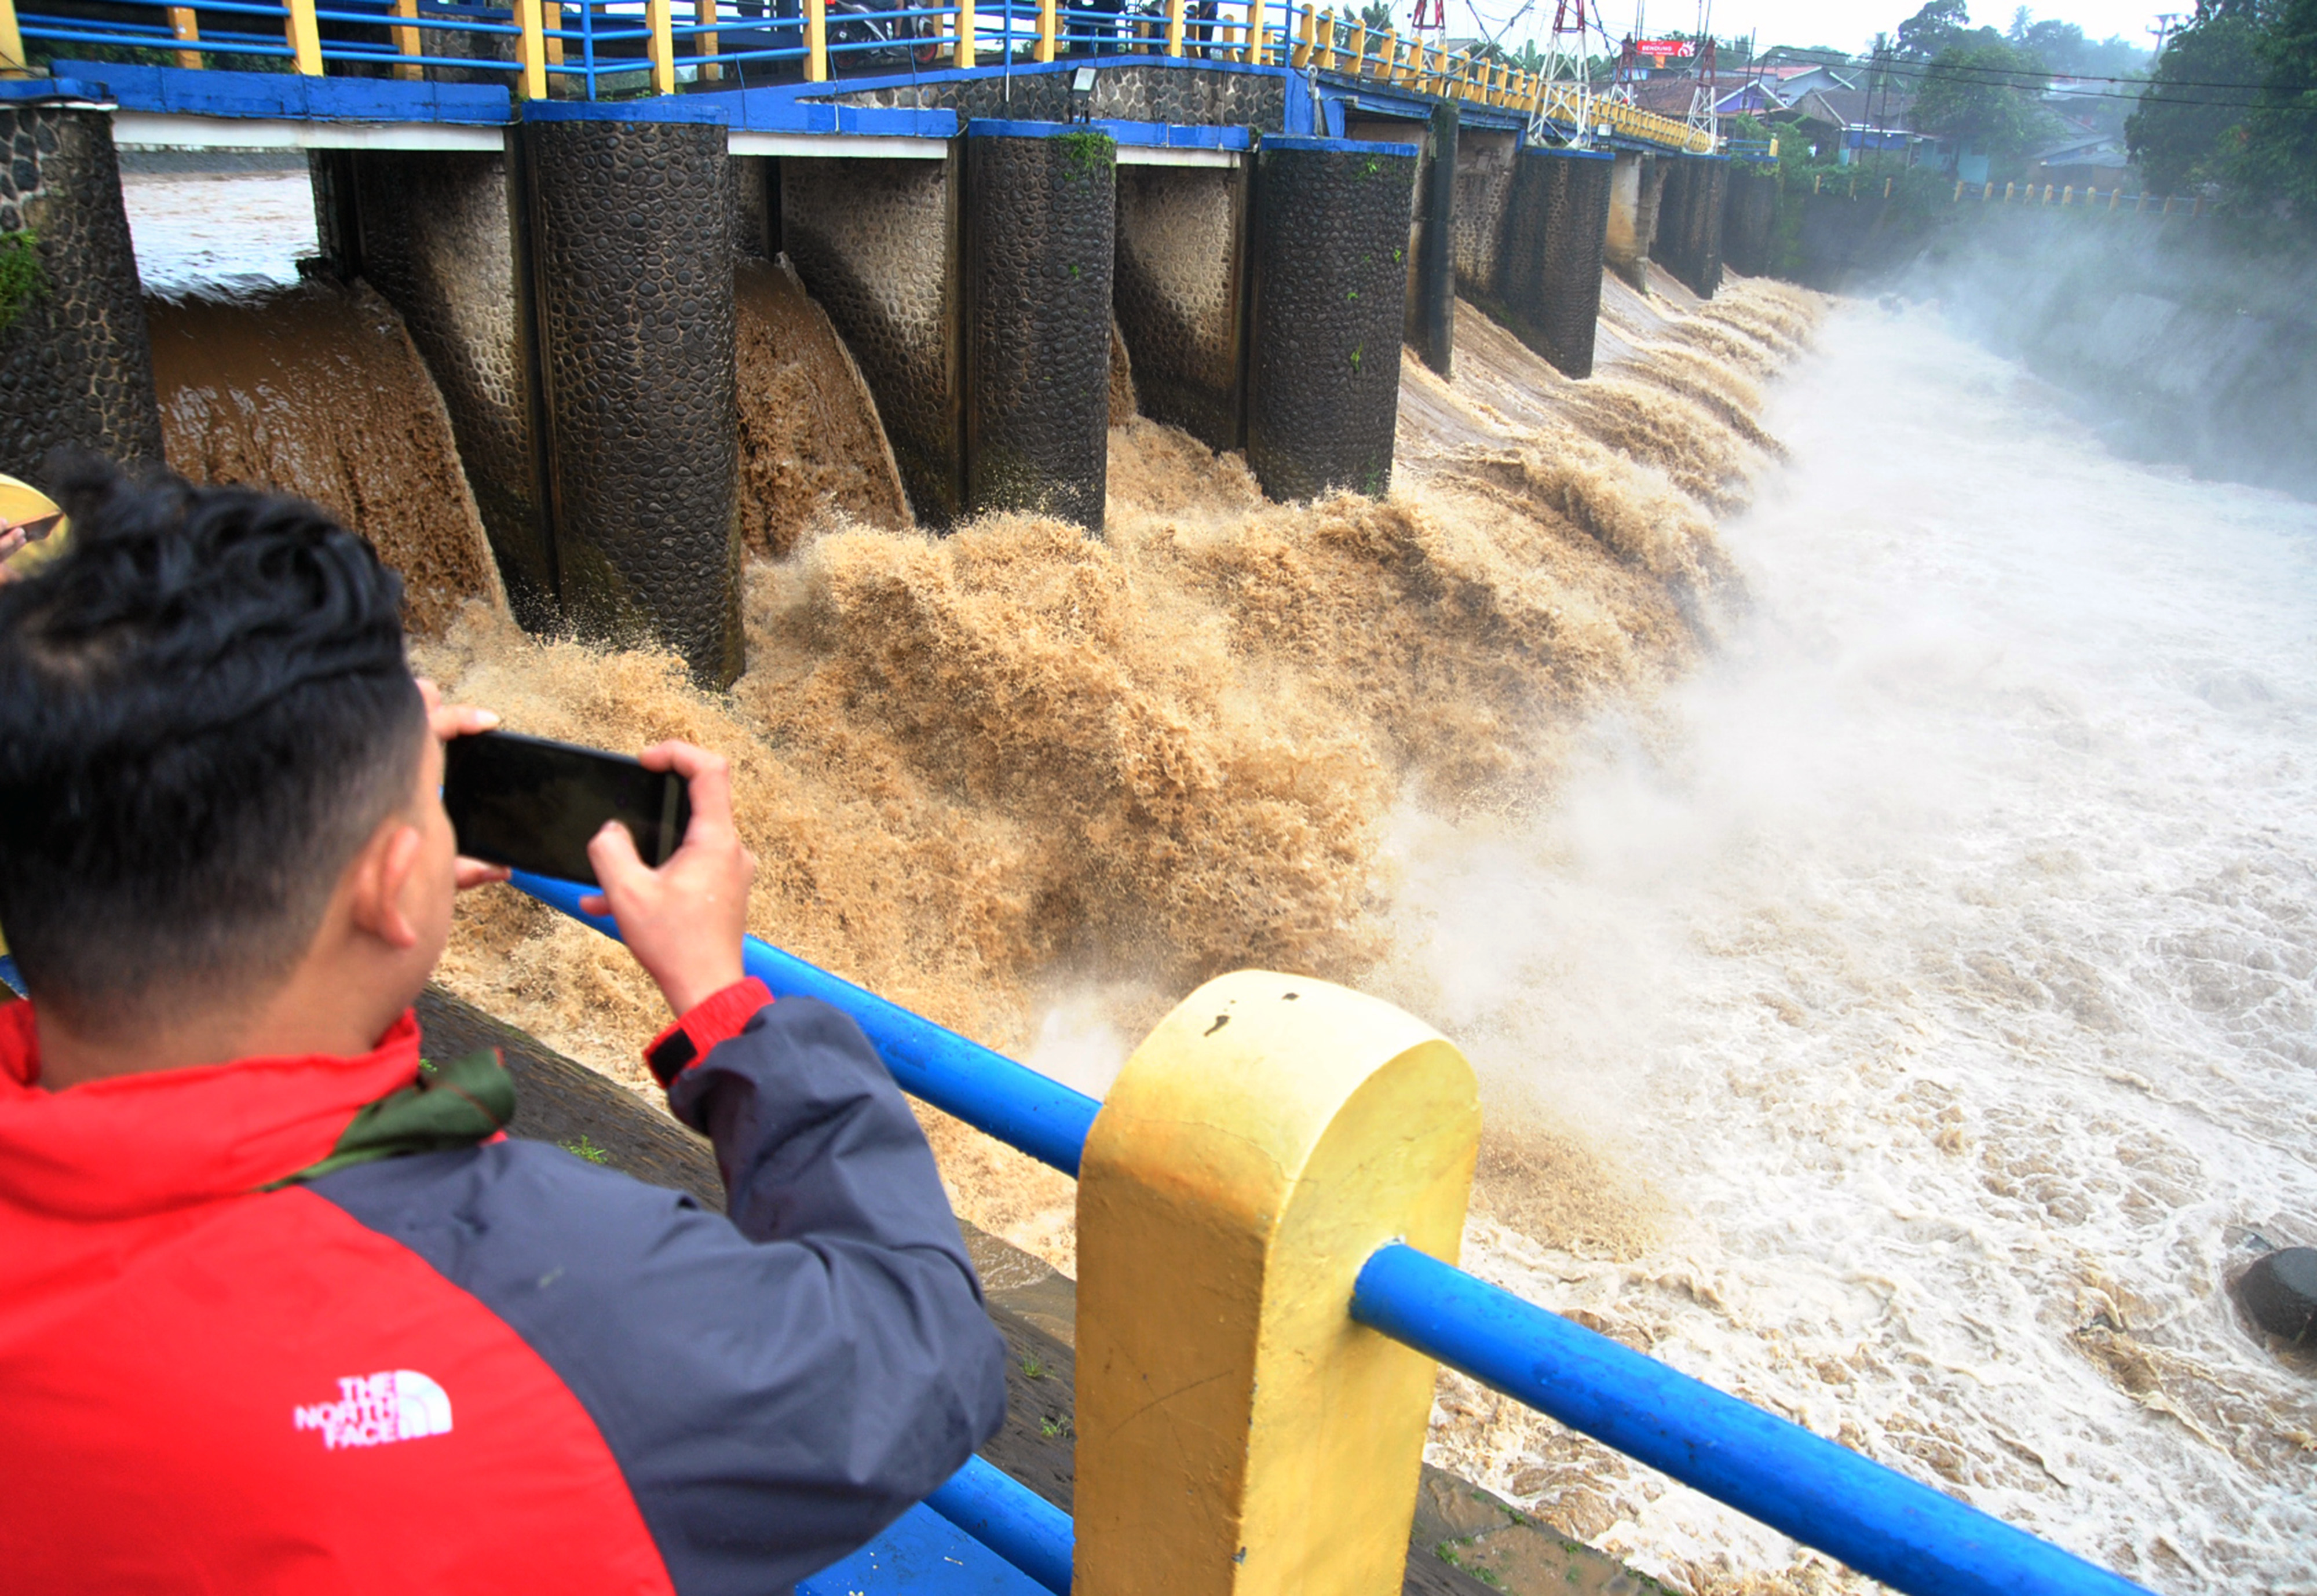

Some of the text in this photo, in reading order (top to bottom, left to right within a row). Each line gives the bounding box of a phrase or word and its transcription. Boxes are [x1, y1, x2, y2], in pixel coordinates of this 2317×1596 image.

[337, 1372, 395, 1400] THE
[294, 1394, 396, 1430] NORTH
[323, 1419, 397, 1449] FACE
